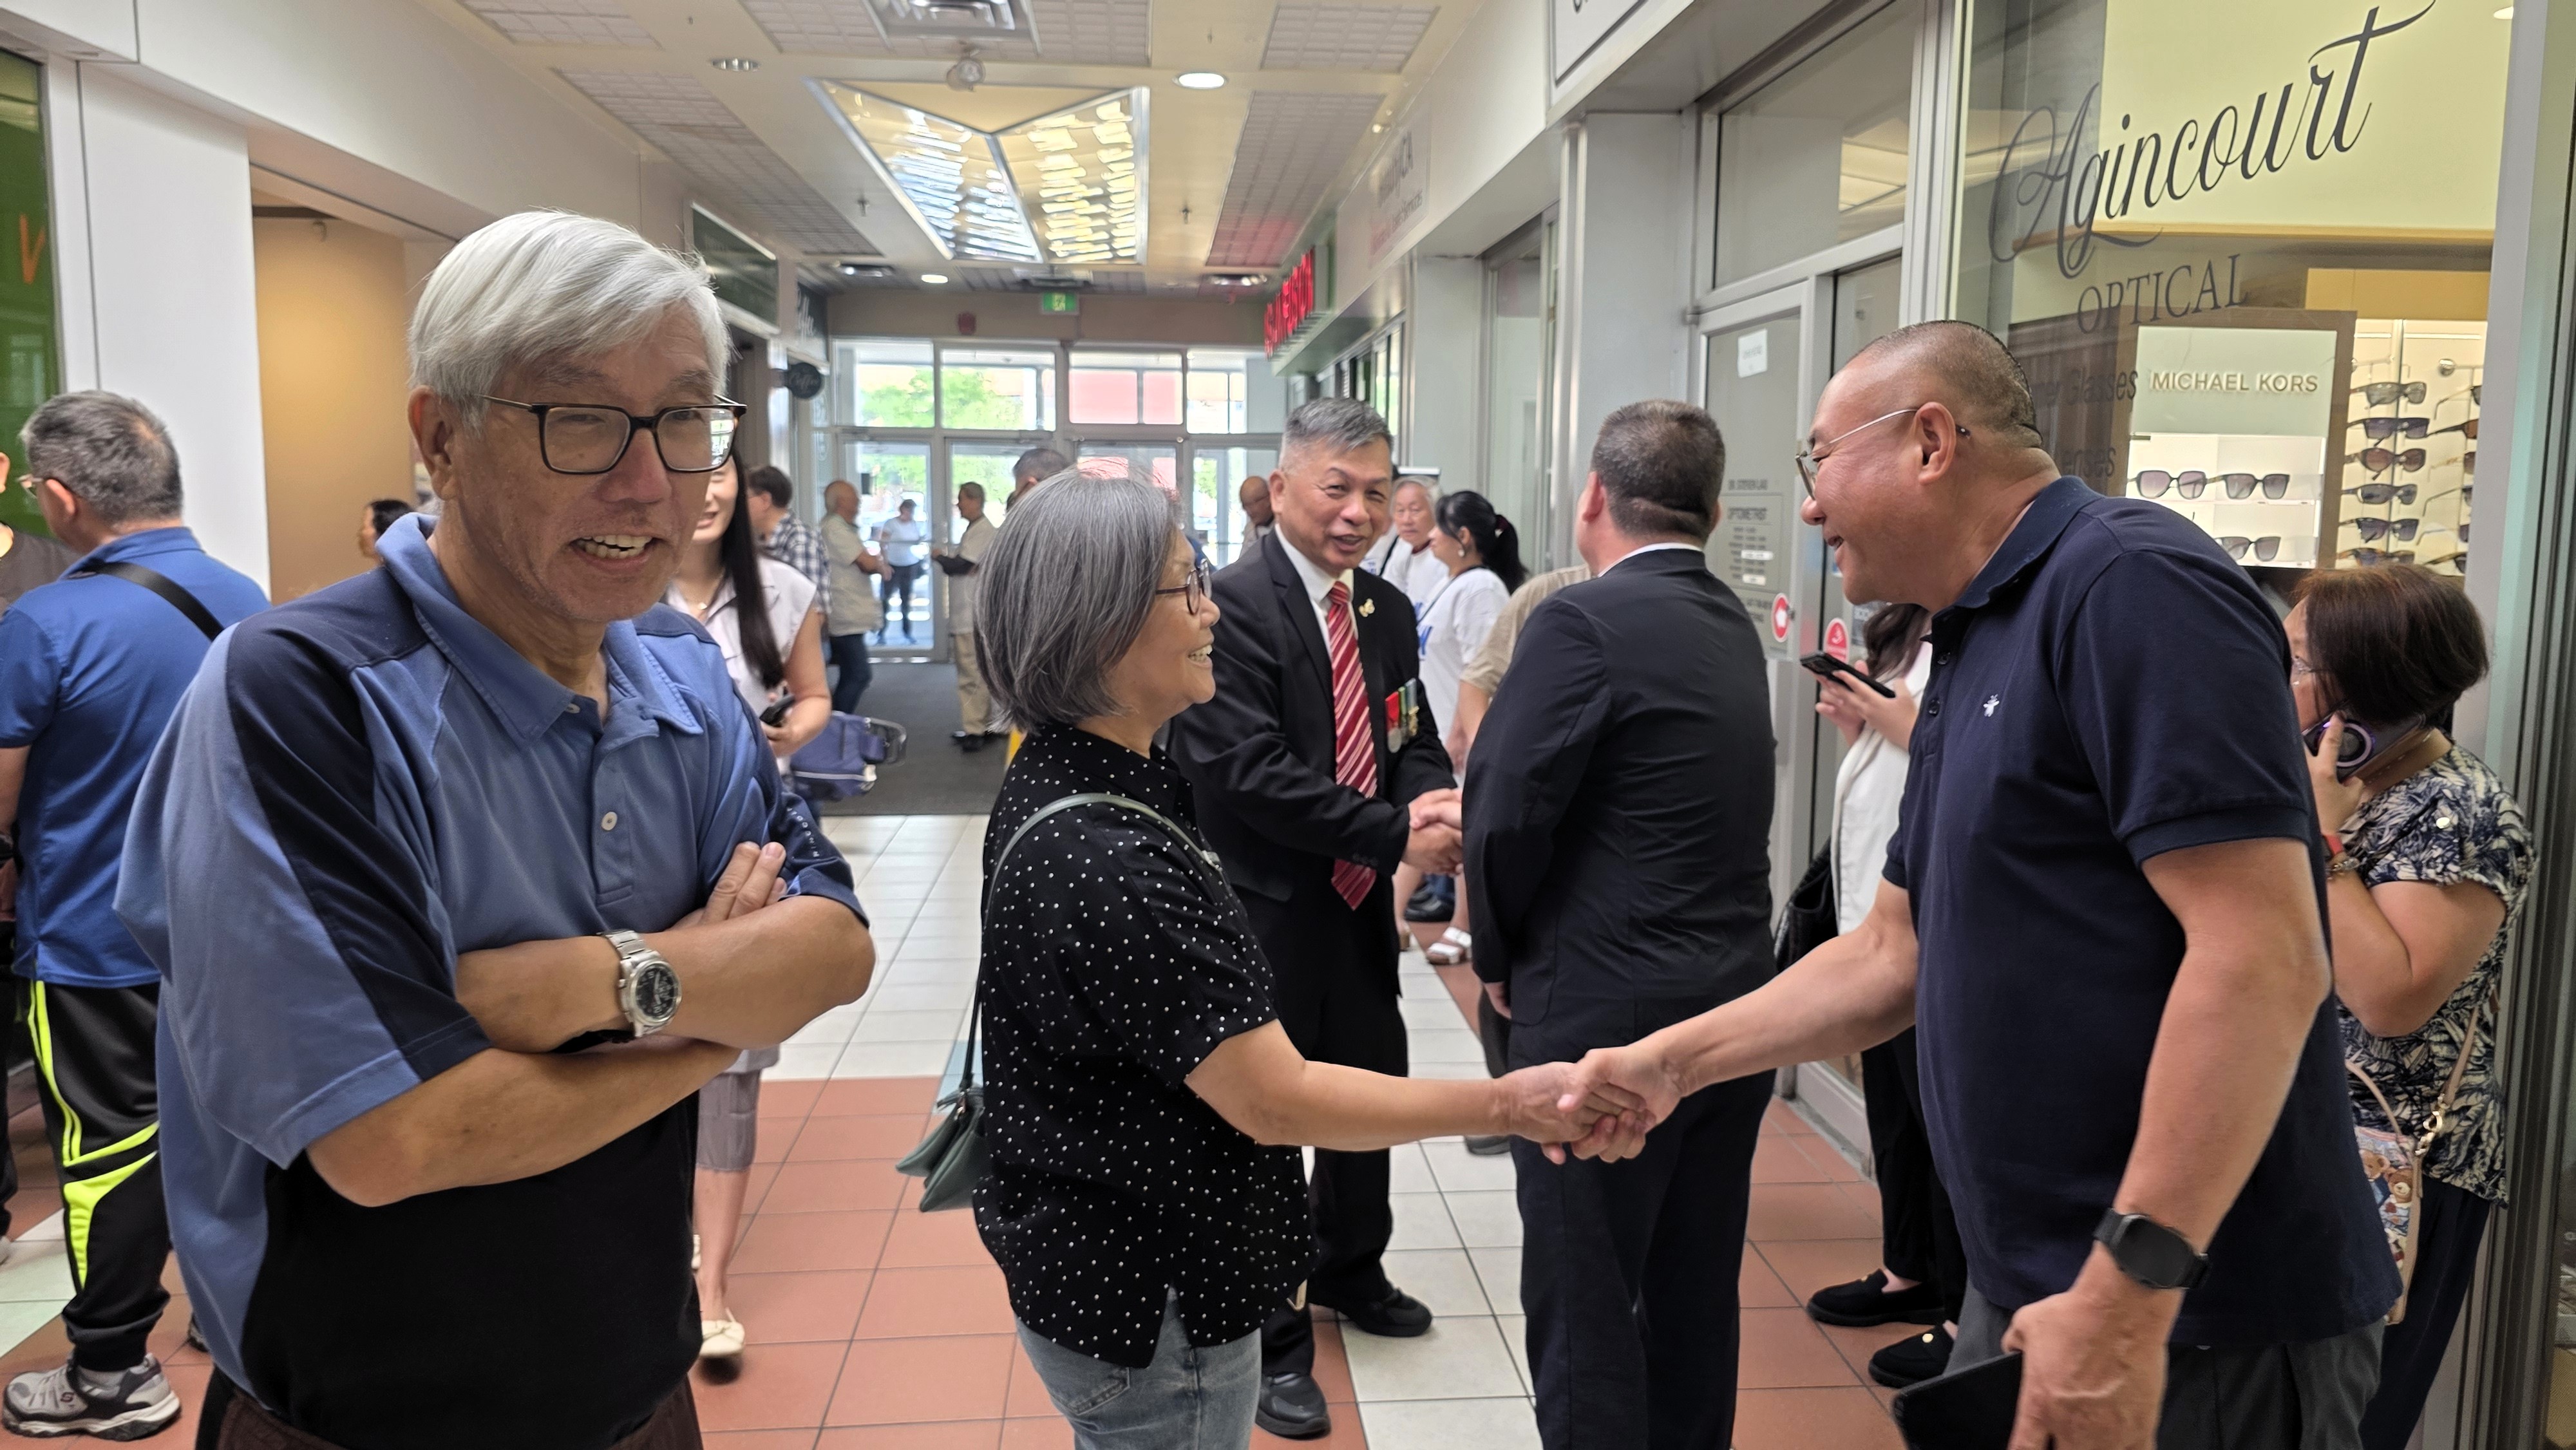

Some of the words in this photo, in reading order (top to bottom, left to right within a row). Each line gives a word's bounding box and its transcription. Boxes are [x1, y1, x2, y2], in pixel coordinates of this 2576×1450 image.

[1988, 0, 2436, 279] Agincourt
[2077, 254, 2250, 335] OPTICAL
[2152, 370, 2249, 391] MICHAEL
[2257, 373, 2318, 393] KORS
